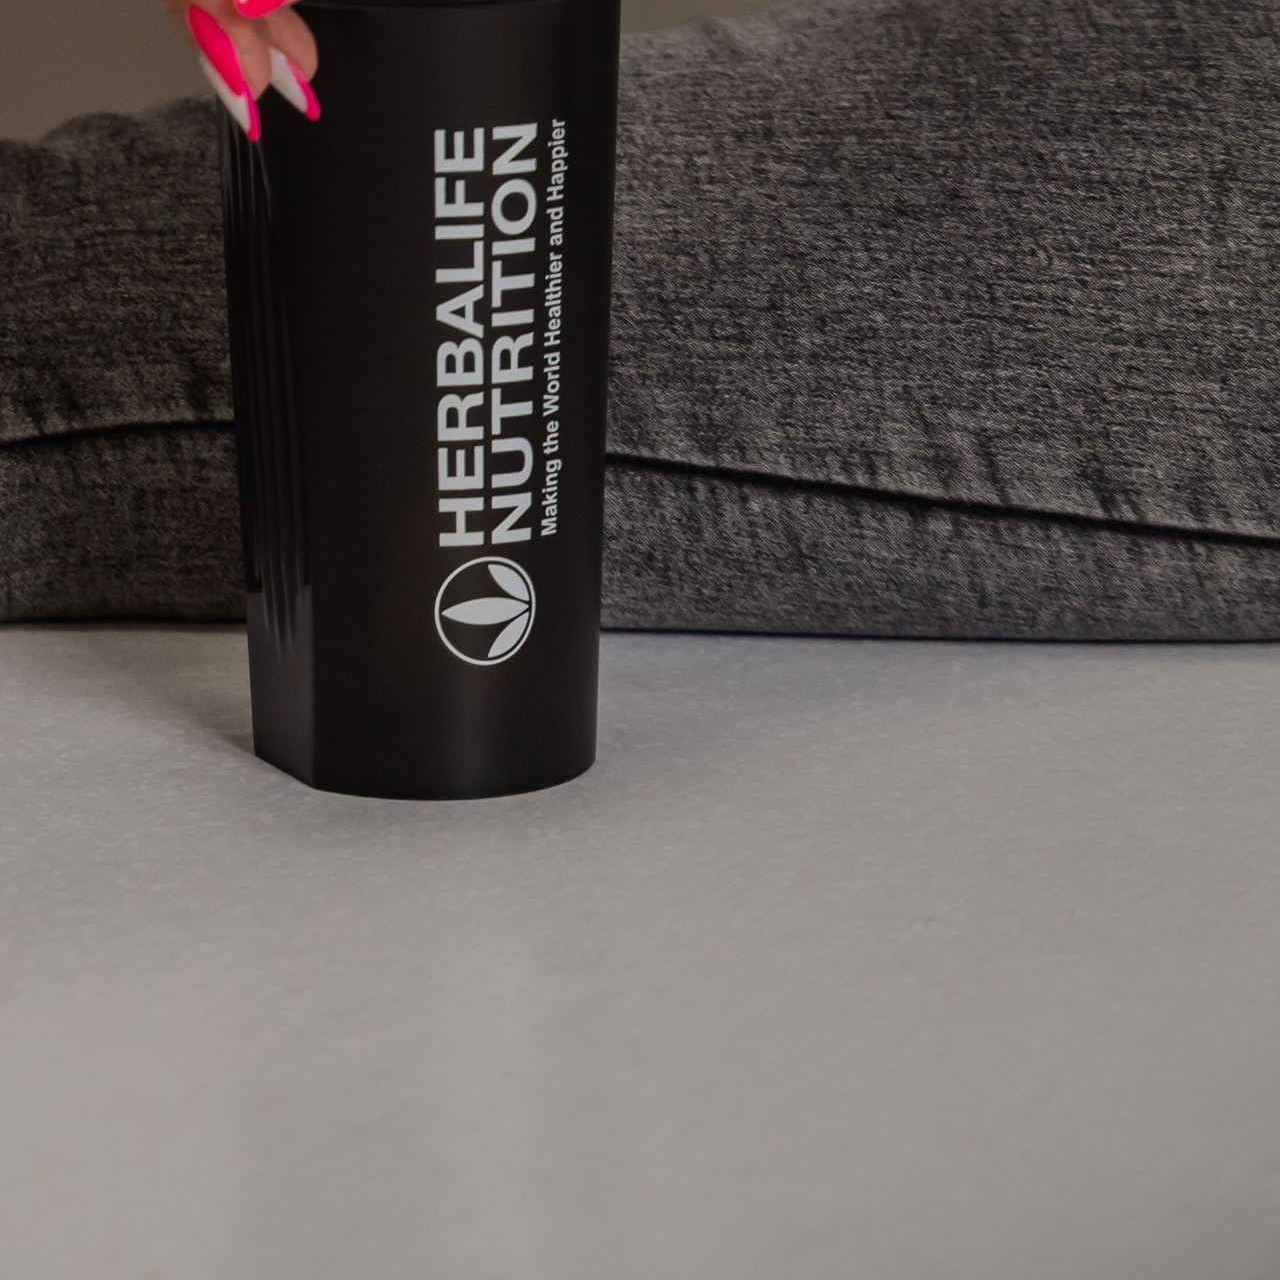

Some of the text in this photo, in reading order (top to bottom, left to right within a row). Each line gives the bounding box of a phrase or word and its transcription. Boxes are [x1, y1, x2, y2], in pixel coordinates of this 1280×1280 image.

[433, 126, 485, 548] HERBALIFE
[490, 122, 538, 545] NUTRITION
[541, 118, 569, 537] Making the World Healthier and Happier
